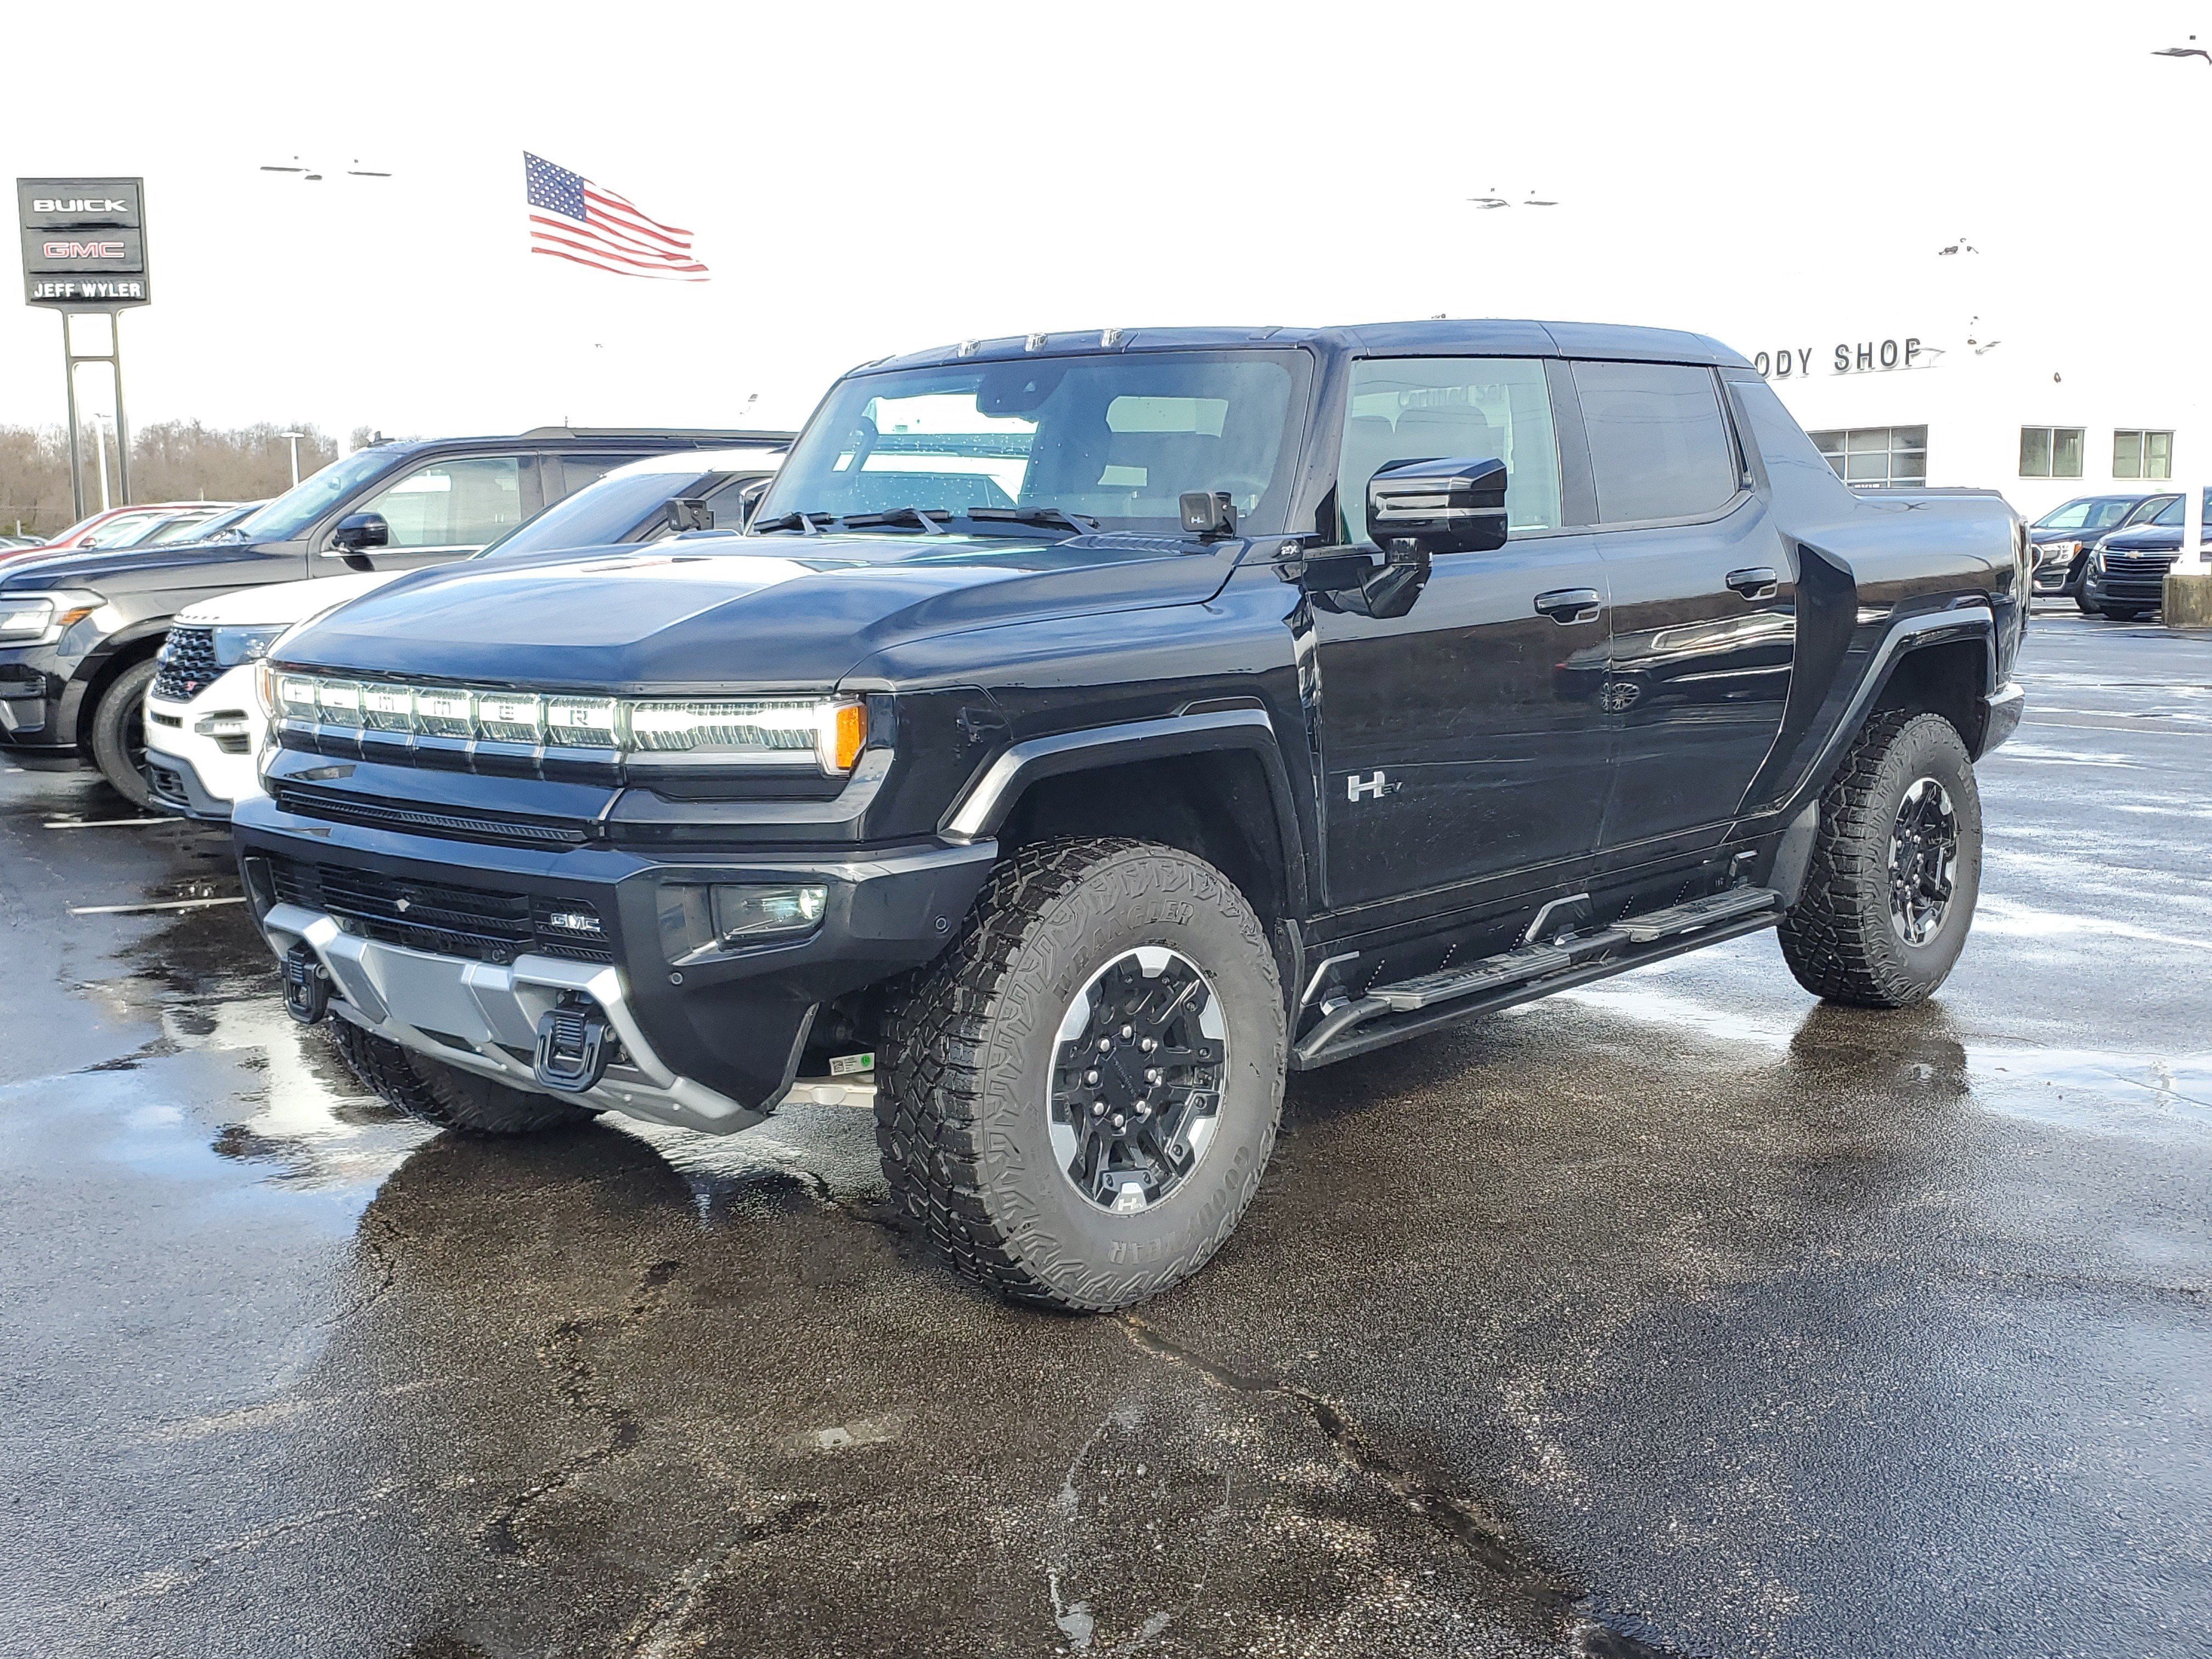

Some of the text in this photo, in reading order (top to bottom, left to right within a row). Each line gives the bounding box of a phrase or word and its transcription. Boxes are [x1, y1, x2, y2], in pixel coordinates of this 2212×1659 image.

[33, 199, 128, 212] BUICK
[43, 241, 125, 258] GMC
[33, 283, 140, 297] JEFF WYLER
[1754, 338, 1922, 377] ODY SHOP
[550, 913, 600, 932] GMC
